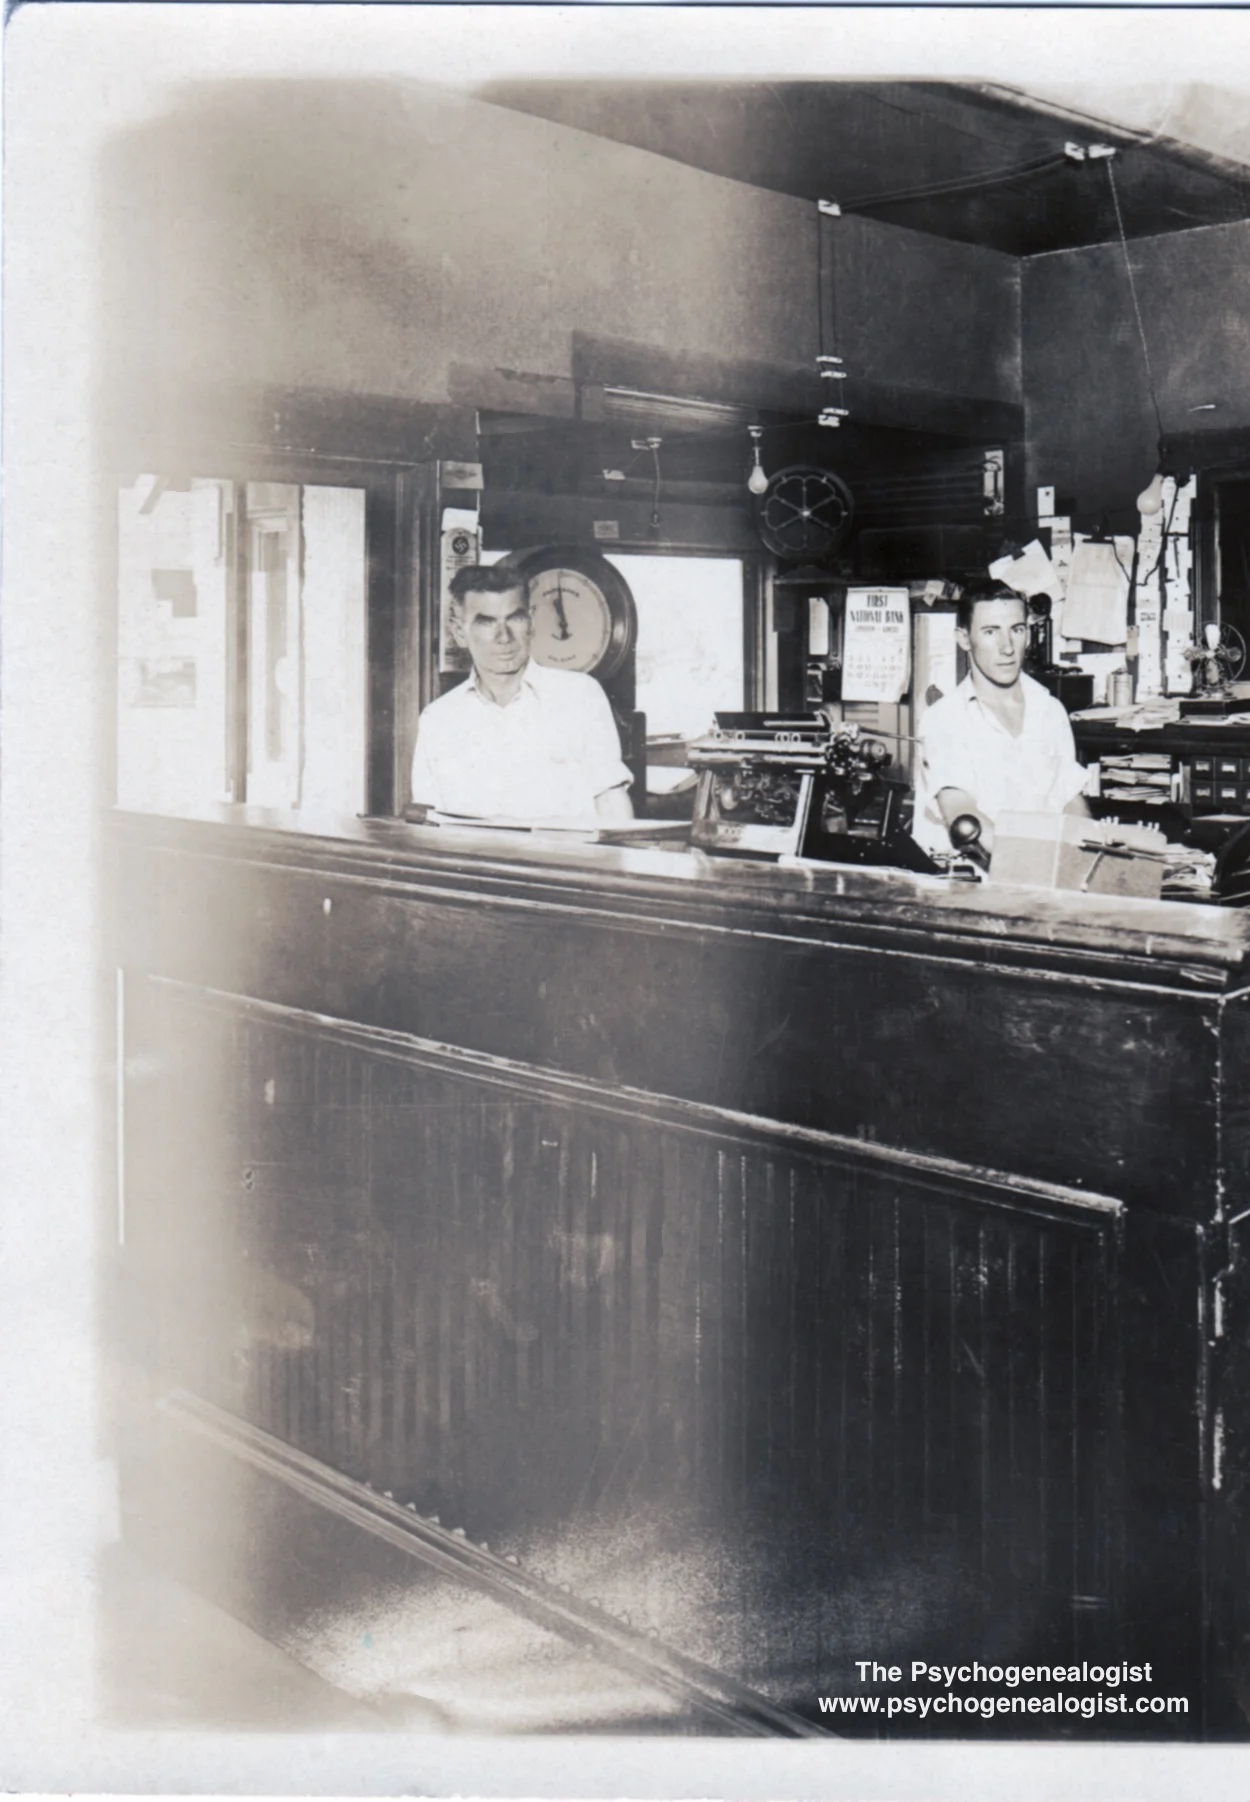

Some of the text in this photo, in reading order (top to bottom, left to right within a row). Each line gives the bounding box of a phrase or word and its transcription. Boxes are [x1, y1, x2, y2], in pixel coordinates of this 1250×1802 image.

[866, 594, 888, 608] FIRST
[850, 610, 904, 623] NATIONAL BANK
